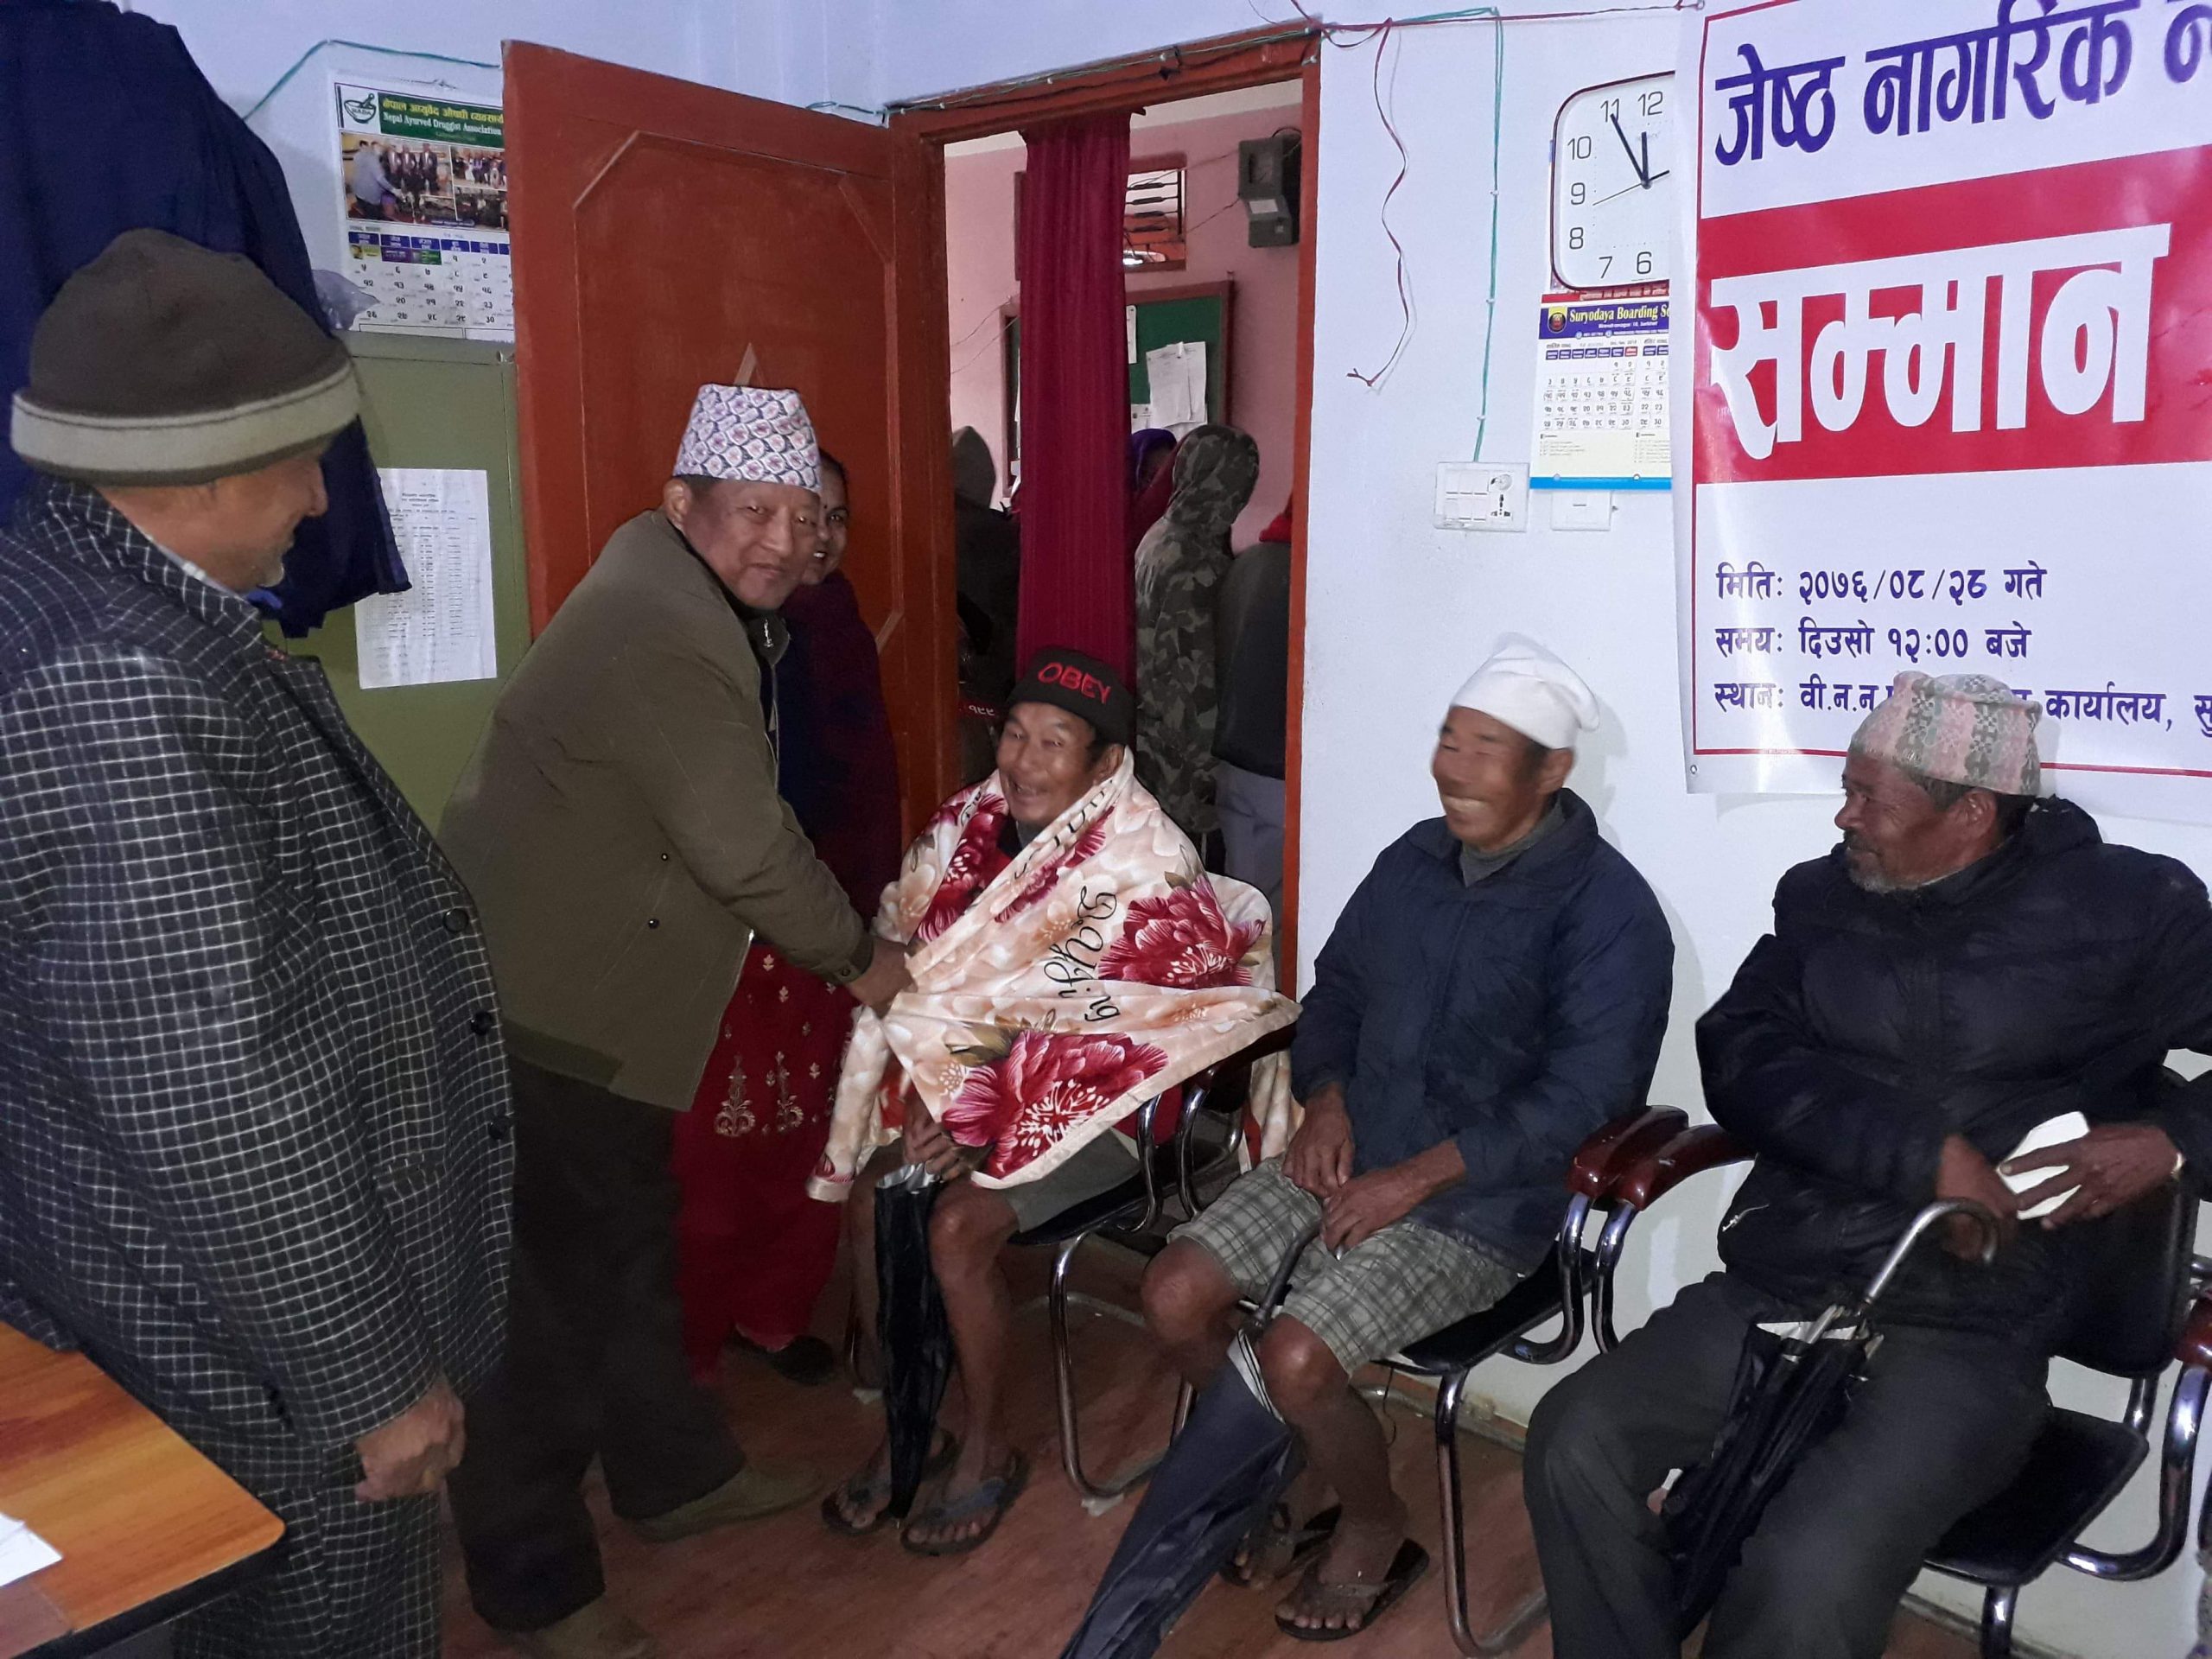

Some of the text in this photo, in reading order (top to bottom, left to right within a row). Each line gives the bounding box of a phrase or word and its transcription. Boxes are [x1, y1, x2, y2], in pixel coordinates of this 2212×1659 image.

[1715, 43, 1846, 166] जेष्ठ
[1864, 0, 2140, 137] नागरिक
[1638, 91, 1663, 117] 12
[383, 111, 403, 124] Nepal
[1567, 136, 1592, 161] 10
[1570, 182, 1586, 205] 9
[1569, 227, 1584, 250] 8
[1599, 256, 1613, 279] 7
[1637, 251, 1652, 274] 6
[1570, 308, 1614, 324] Suryodaya
[1618, 305, 1658, 321] Boarding
[1710, 223, 2171, 460] सम्मान
[1715, 561, 1783, 600] मिति:
[2004, 560, 2047, 600] गते
[1714, 616, 2032, 664] समय: दिउसो १२:०० बजे
[1038, 662, 1111, 704] OBEY
[1713, 683, 1783, 712] स्थान:
[2044, 681, 2172, 732] कार्यालय,
